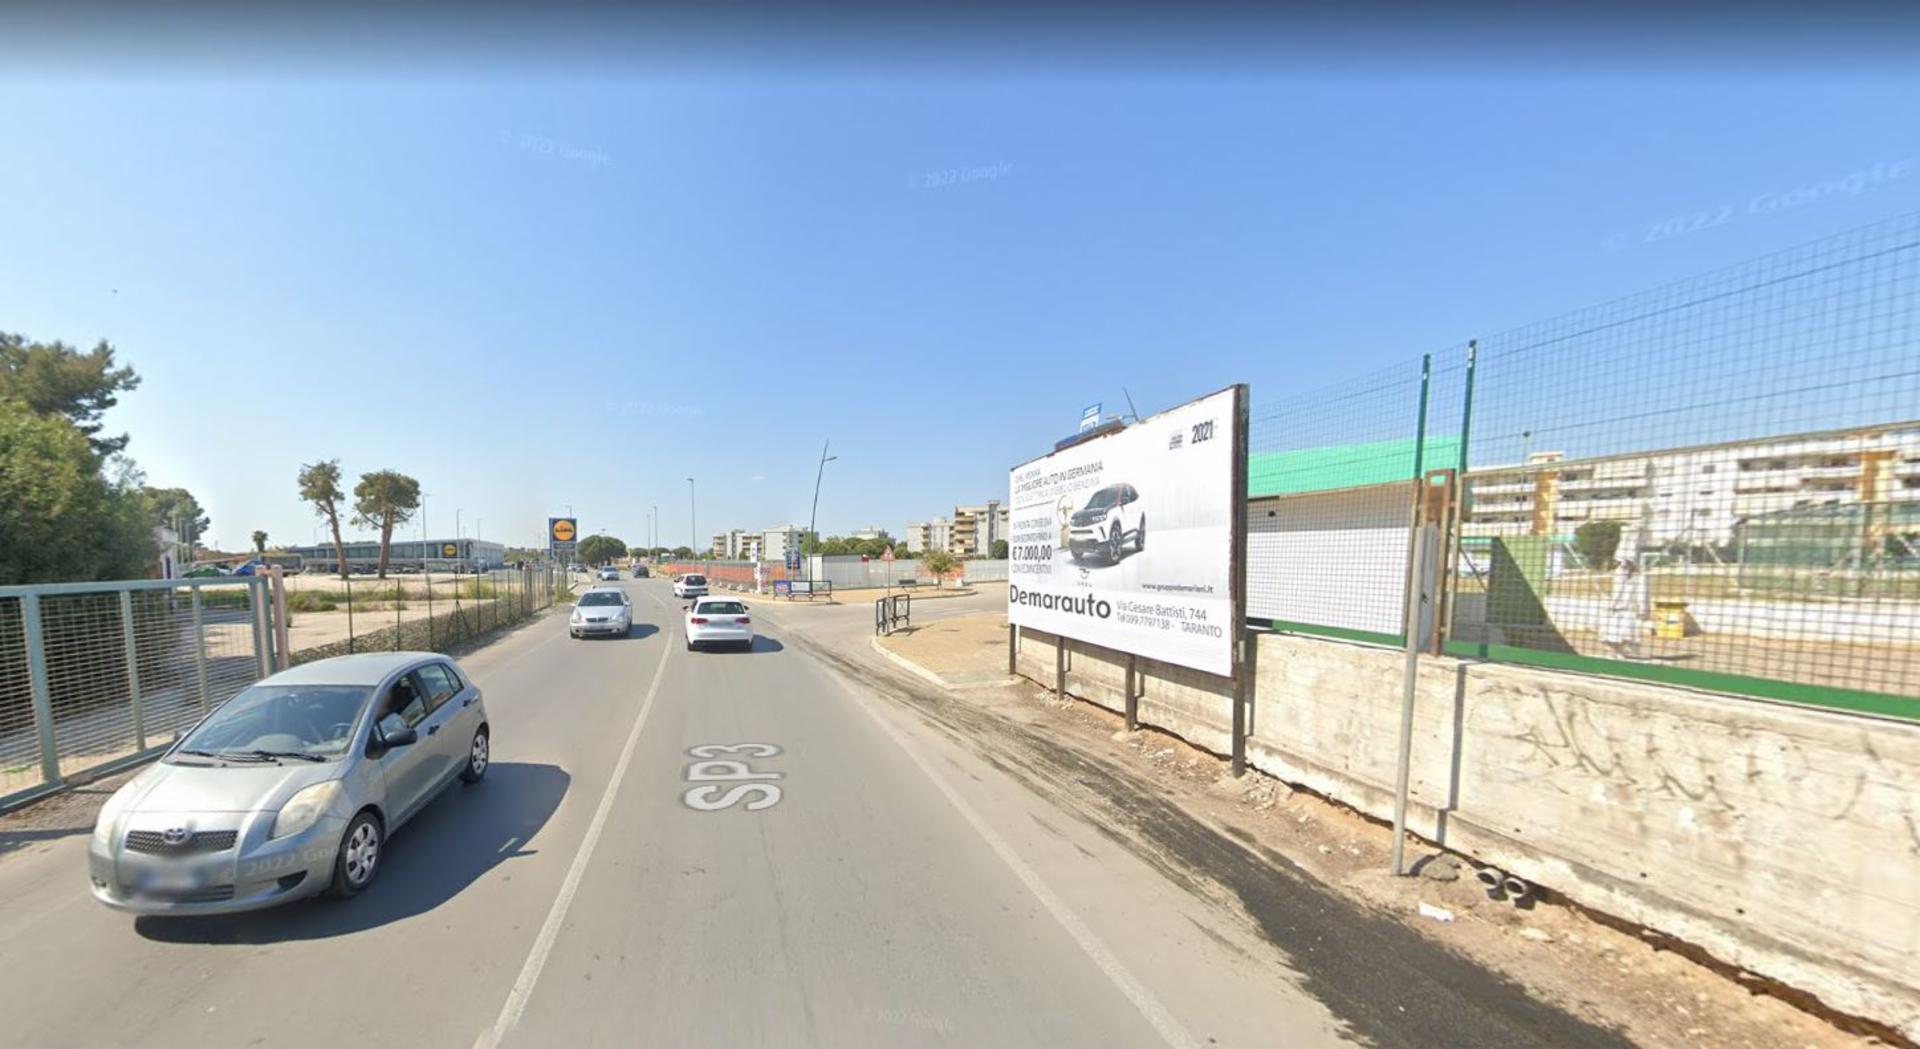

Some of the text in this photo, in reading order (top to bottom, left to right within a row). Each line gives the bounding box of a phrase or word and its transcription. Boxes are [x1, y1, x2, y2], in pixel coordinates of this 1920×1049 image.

[1191, 419, 1214, 445] 2021
[1043, 472, 1059, 486] AUTO
[1060, 471, 1067, 481] IN
[1067, 460, 1104, 481] GERMANIA
[1012, 544, 1052, 563] € 7.000,00
[1009, 584, 1111, 619] Demarauto
[1116, 600, 1207, 621] Via Cesare Battisti, 744
[1180, 620, 1222, 638] TARANTO
